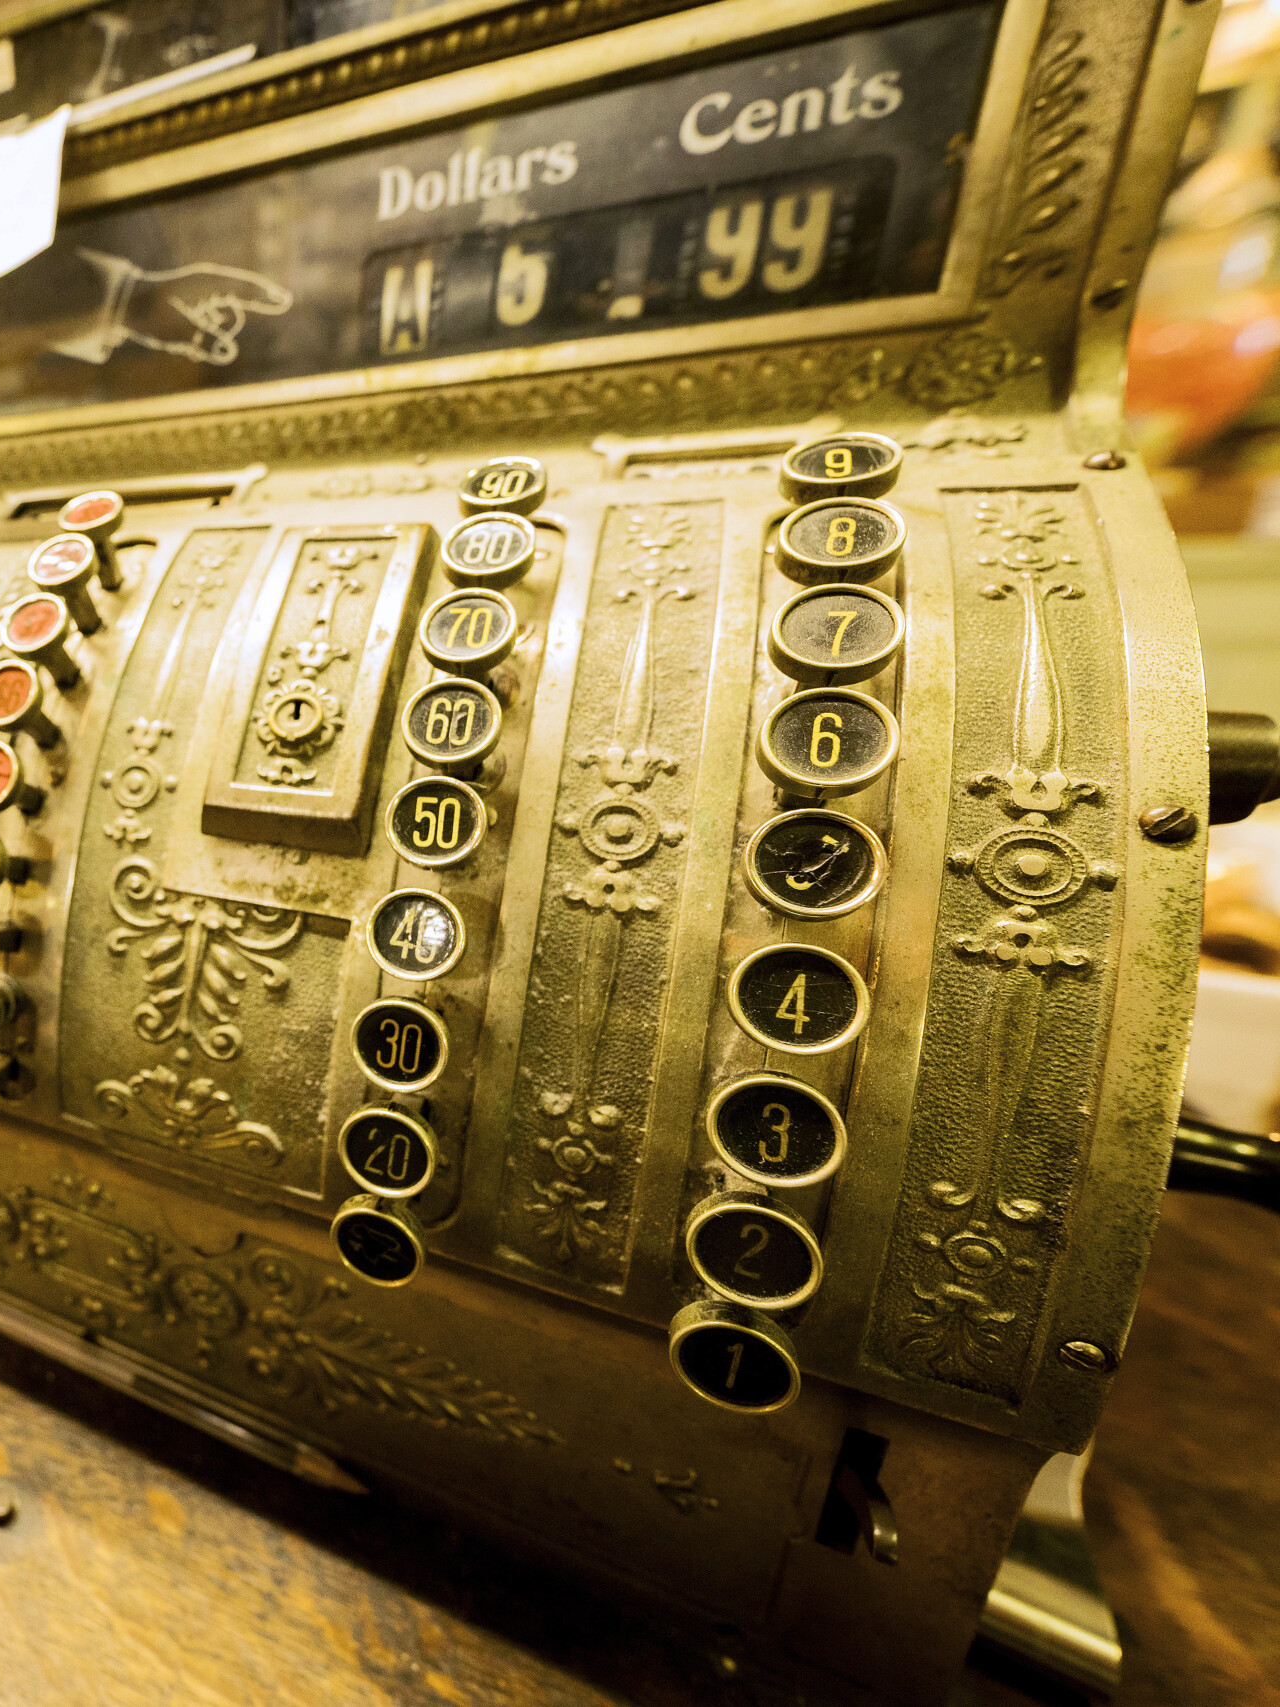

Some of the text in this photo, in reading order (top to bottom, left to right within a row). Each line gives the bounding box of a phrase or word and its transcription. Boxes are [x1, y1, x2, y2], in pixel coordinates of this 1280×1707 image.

[679, 68, 904, 156] Cents
[376, 138, 579, 221] Dollars
[699, 190, 833, 299] 99
[479, 470, 526, 498] 90
[824, 448, 852, 476] 9
[463, 534, 511, 565] 80
[825, 516, 855, 556] 8
[445, 606, 493, 649] 70
[827, 610, 856, 658] 7
[425, 698, 476, 746] 60
[810, 712, 842, 768] 6
[411, 797, 461, 849] 50
[774, 973, 809, 1035] 4
[376, 1018, 423, 1074] 30
[363, 1127, 410, 1181] 20
[759, 1102, 791, 1163] 3
[735, 1223, 768, 1279] 2
[726, 1342, 745, 1388] 1
